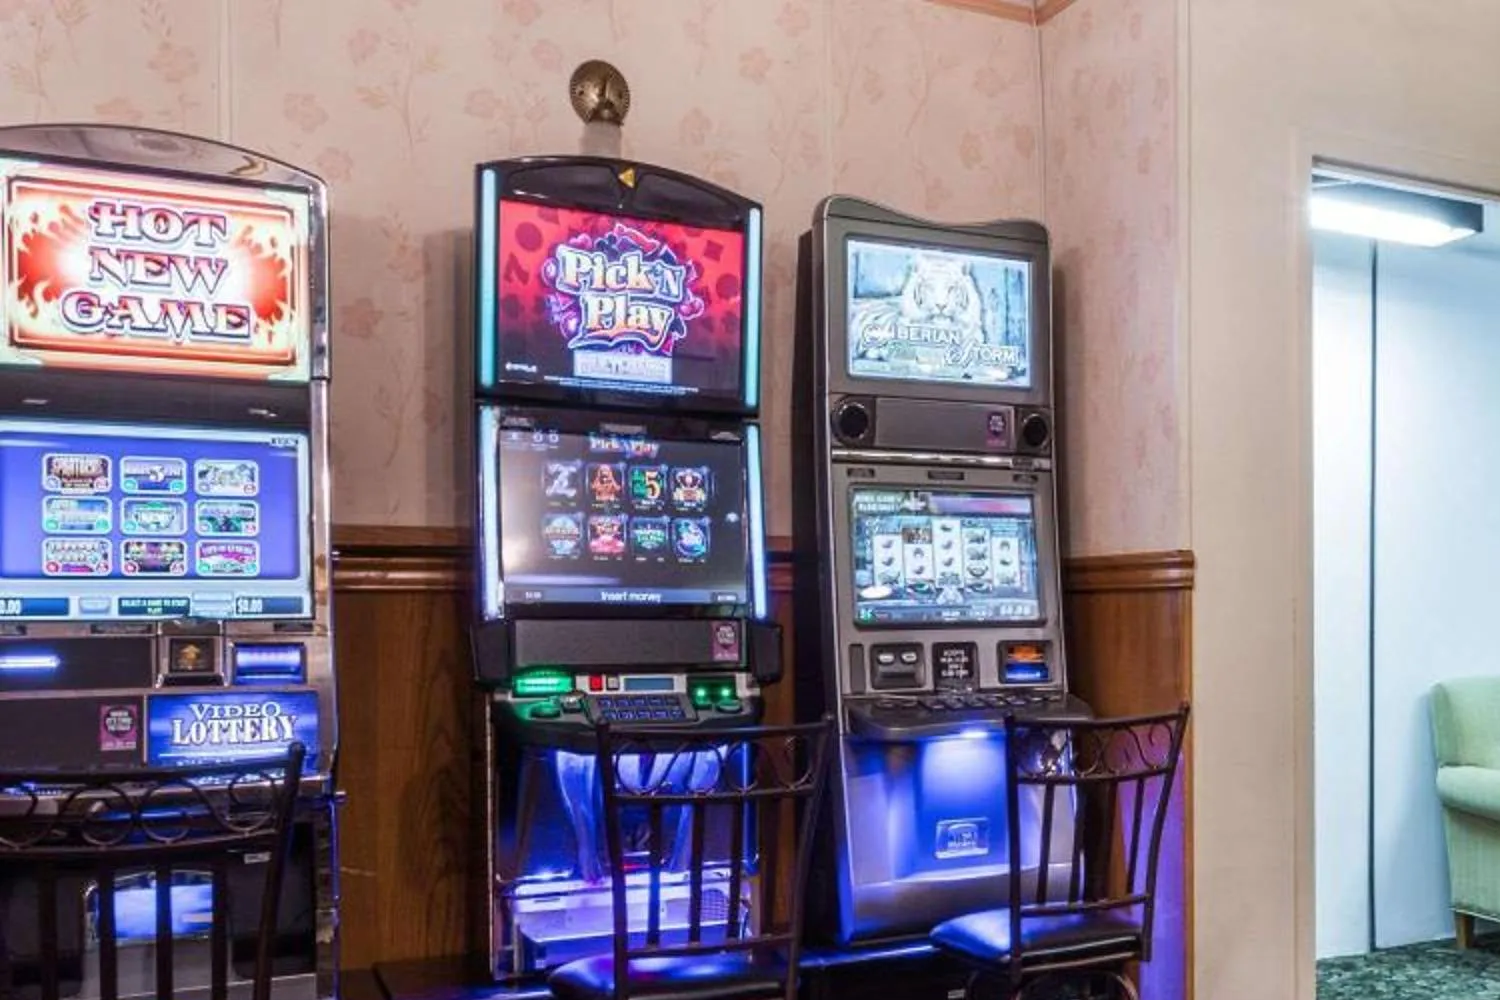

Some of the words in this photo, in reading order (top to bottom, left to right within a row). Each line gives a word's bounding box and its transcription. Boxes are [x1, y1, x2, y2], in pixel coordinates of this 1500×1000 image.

[88, 201, 227, 247] HOT
[88, 247, 228, 294] NEW
[61, 290, 251, 340] GAME
[583, 293, 674, 345] Play
[171, 714, 298, 746] LOTTERY
[190, 701, 281, 721] VIDEO
